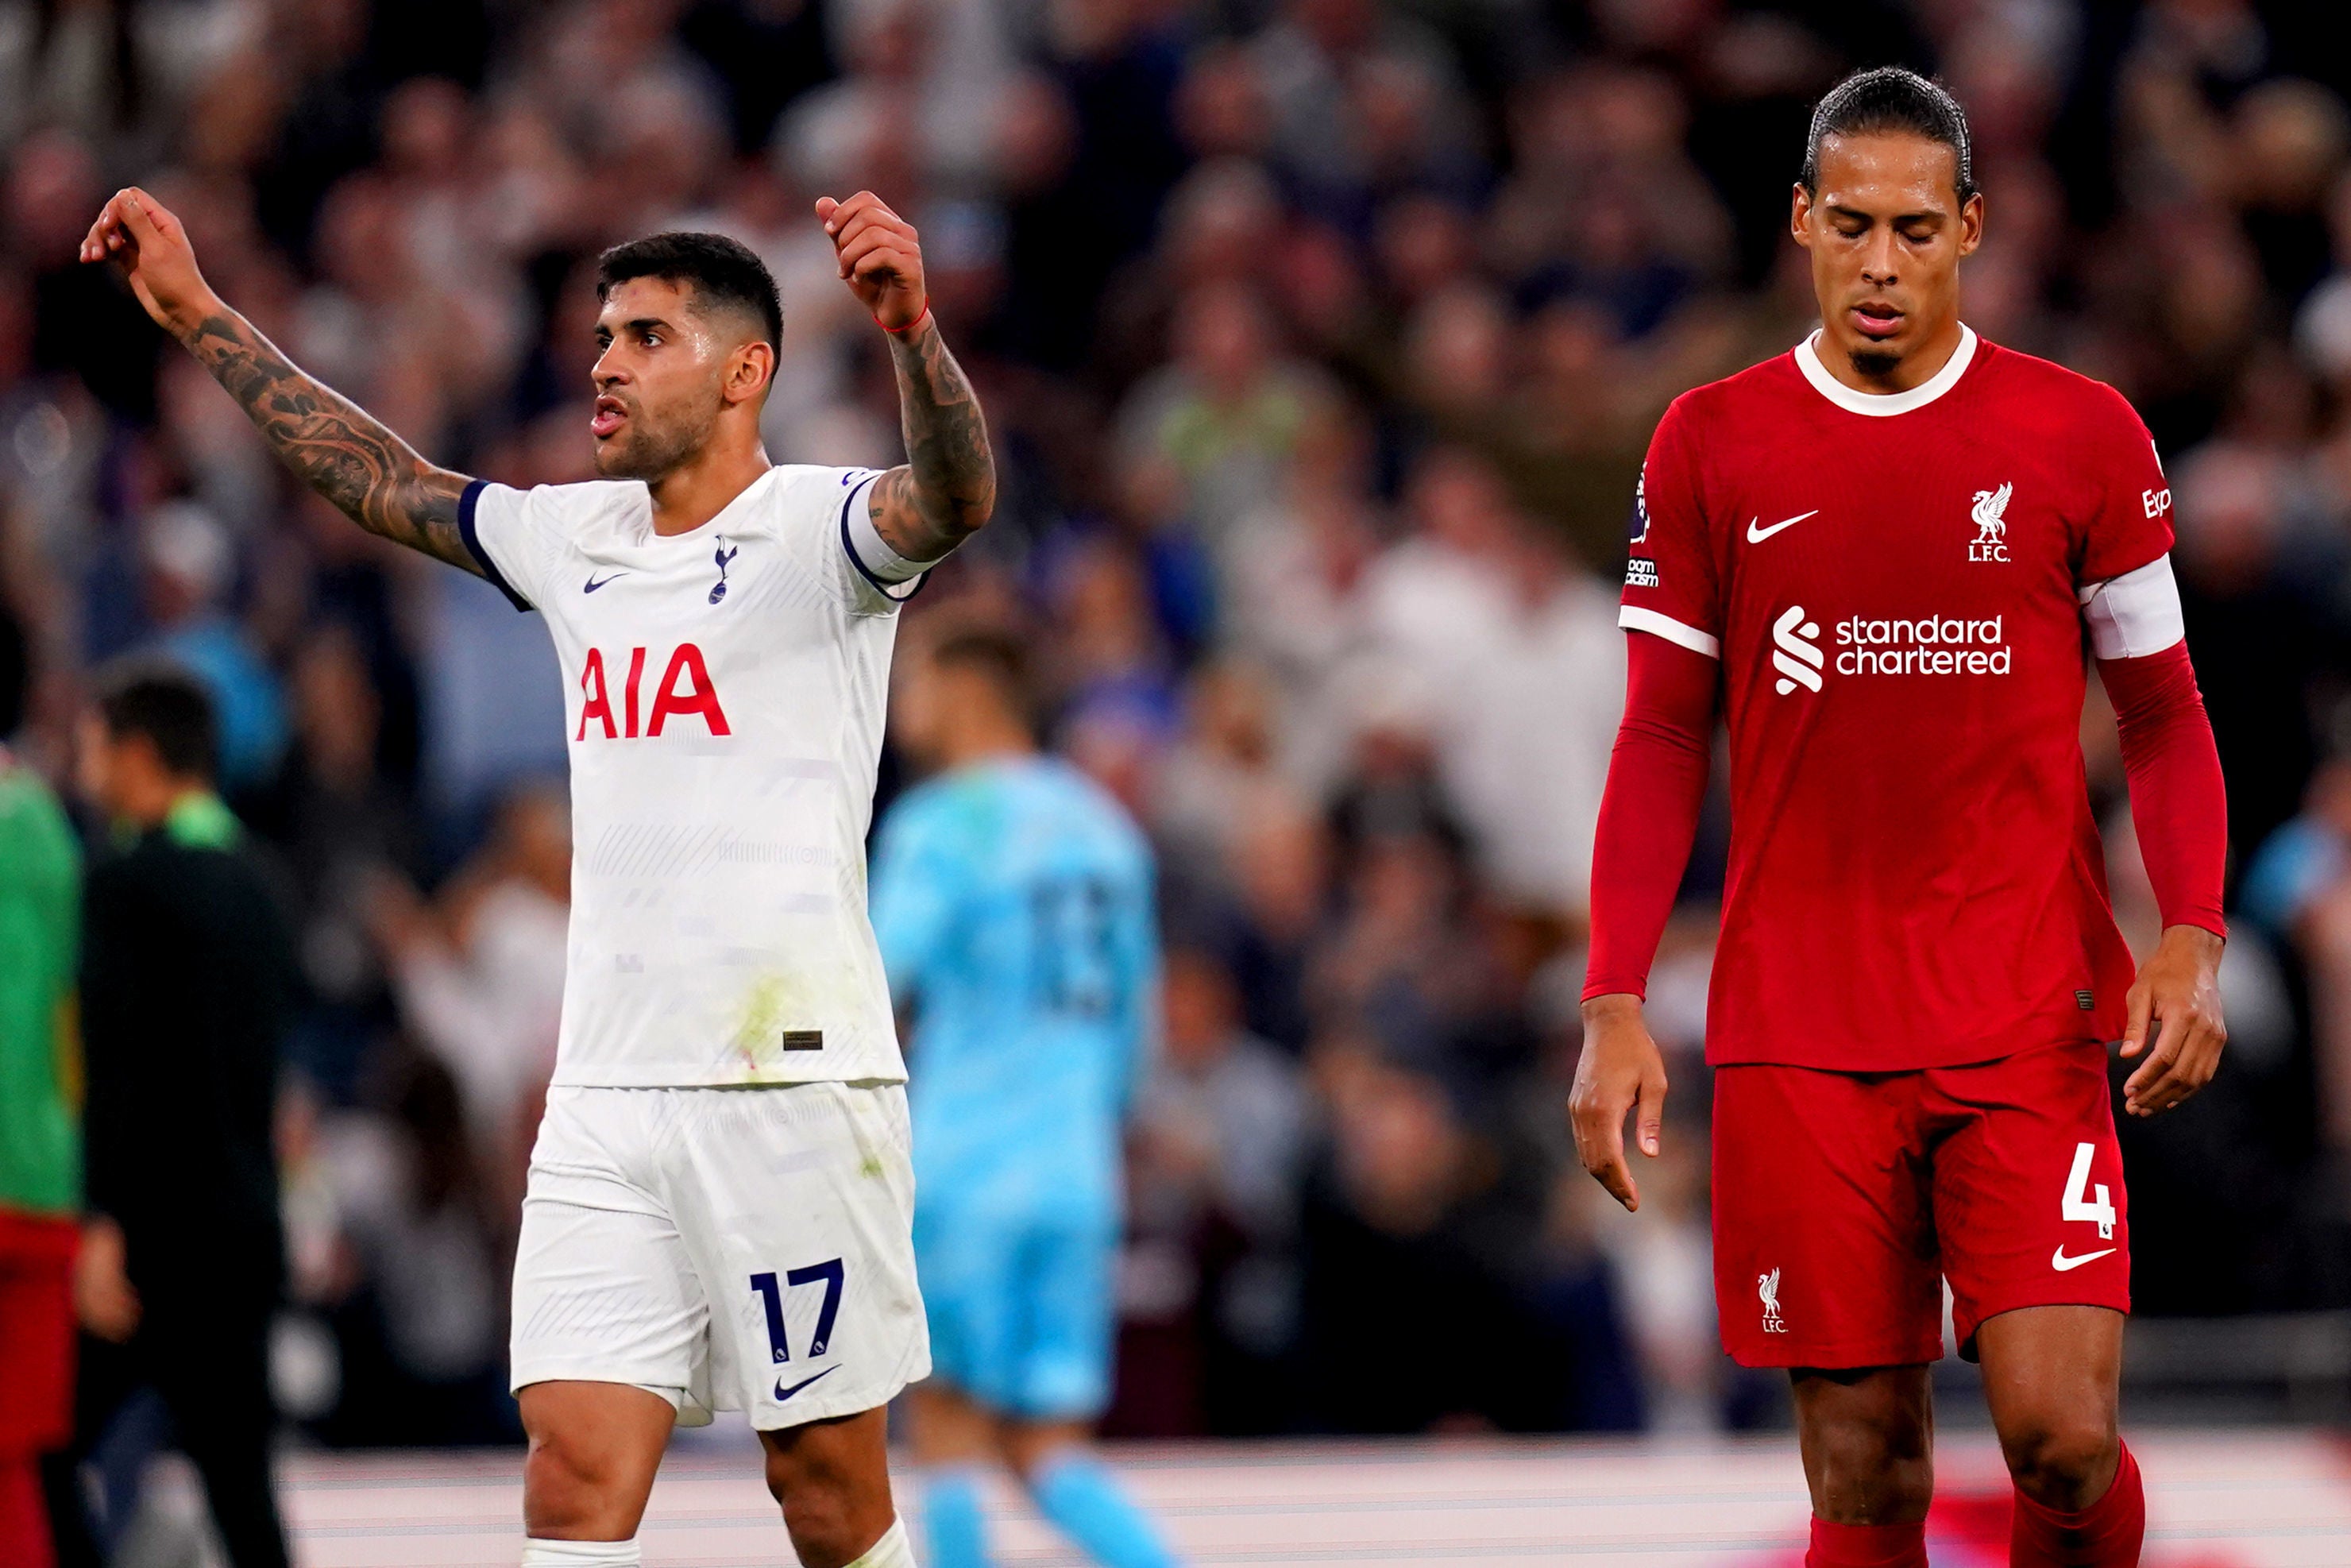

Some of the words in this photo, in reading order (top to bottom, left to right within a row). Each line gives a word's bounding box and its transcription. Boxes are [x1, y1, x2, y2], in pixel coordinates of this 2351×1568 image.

[1968, 544, 2011, 562] L.F.C.
[1835, 613, 2002, 645] standard
[1835, 644, 2012, 676] chartered
[575, 642, 732, 742] AIA
[2061, 1141, 2117, 1241] 4
[749, 1257, 844, 1365] 17
